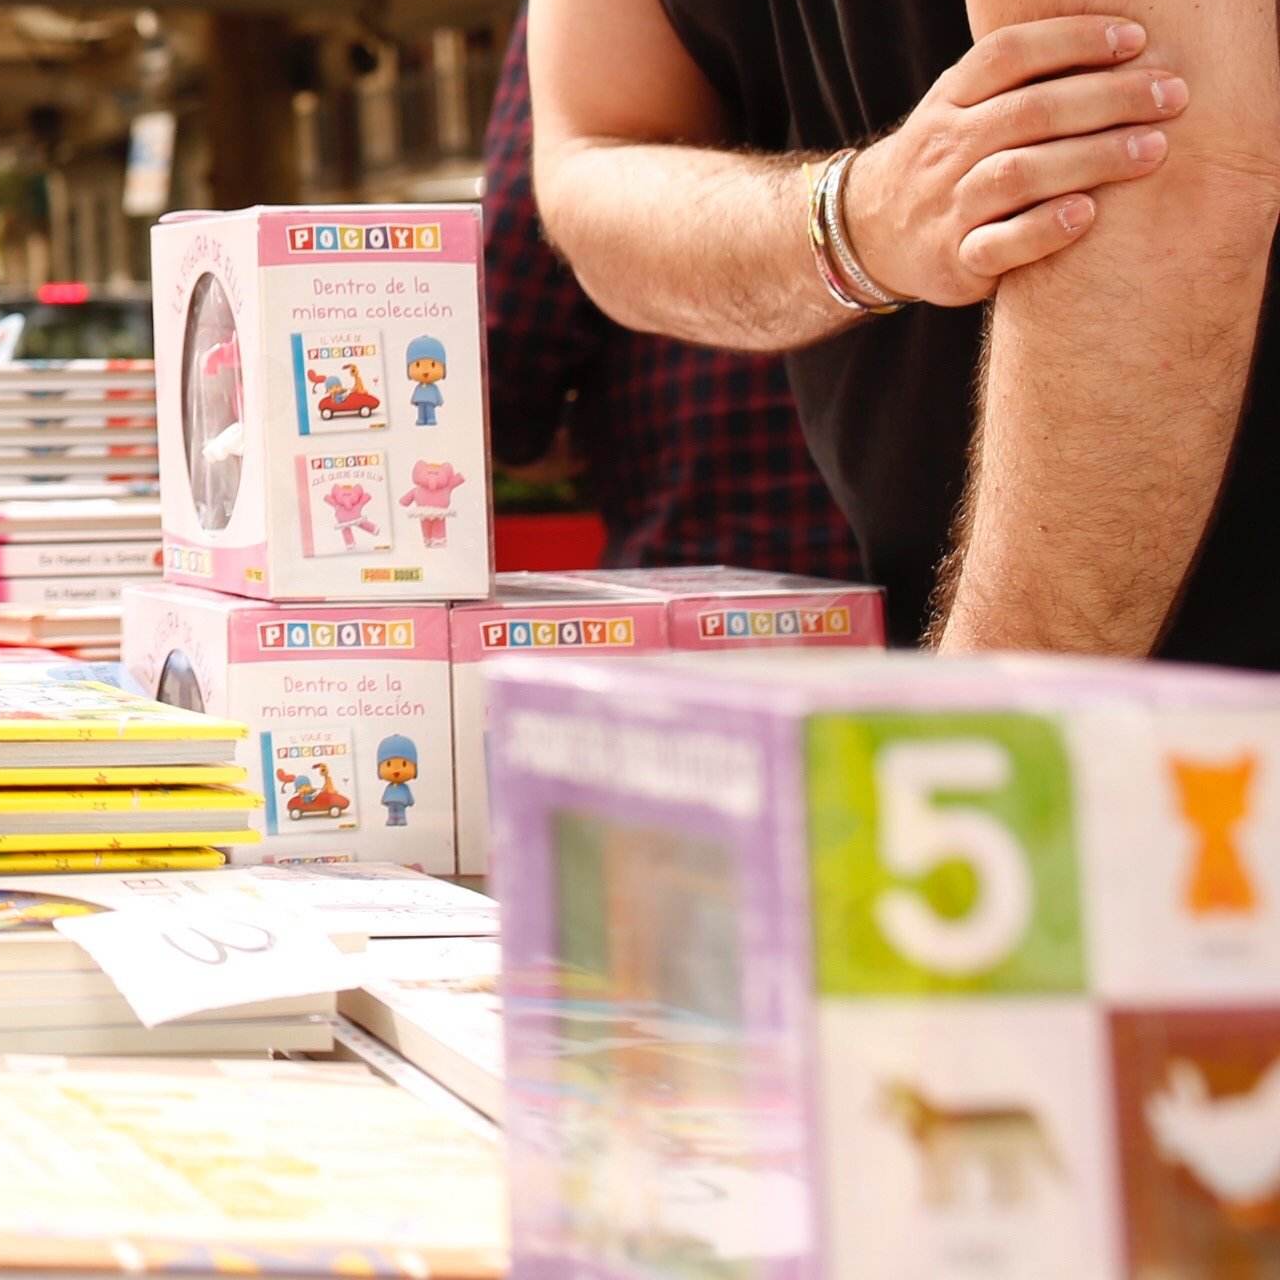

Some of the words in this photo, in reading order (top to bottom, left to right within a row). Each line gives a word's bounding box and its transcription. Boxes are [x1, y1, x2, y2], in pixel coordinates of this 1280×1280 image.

[293, 226, 439, 251] POCOYO
[313, 278, 376, 297] Dentro
[385, 278, 406, 295] de
[413, 277, 430, 294] la
[292, 304, 358, 320] misma
[366, 301, 453, 319] colección
[308, 346, 376, 360] POCOYO
[311, 455, 379, 470] POCOYO
[263, 622, 411, 647] POCOYO
[485, 621, 631, 648] POCOYO
[704, 611, 847, 637] POCOYO
[283, 676, 348, 696] Dentro
[358, 675, 380, 694] de
[386, 674, 403, 693] la
[261, 703, 331, 718] misma
[336, 695, 426, 717] colección
[872, 737, 1035, 977] 5
[160, 918, 278, 966] 3
